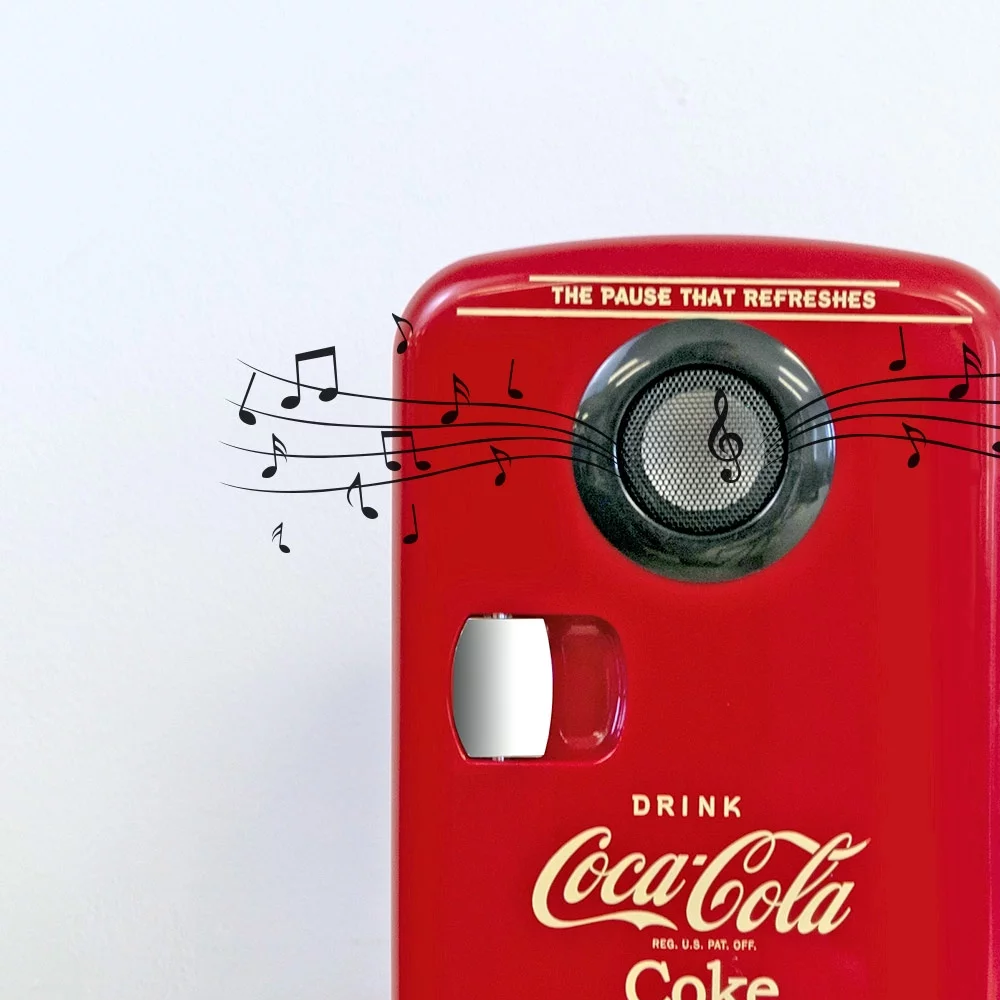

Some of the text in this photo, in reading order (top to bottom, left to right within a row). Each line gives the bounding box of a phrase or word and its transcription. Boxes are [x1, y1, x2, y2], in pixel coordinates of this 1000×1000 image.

[551, 285, 877, 309] THE PAUSE THAT REFRESHES
[632, 794, 741, 818] DRINK
[532, 826, 869, 935] Coca-Cola
[652, 938, 678, 950] REG.
[681, 939, 704, 950] U.S.
[707, 939, 730, 951] PAT.
